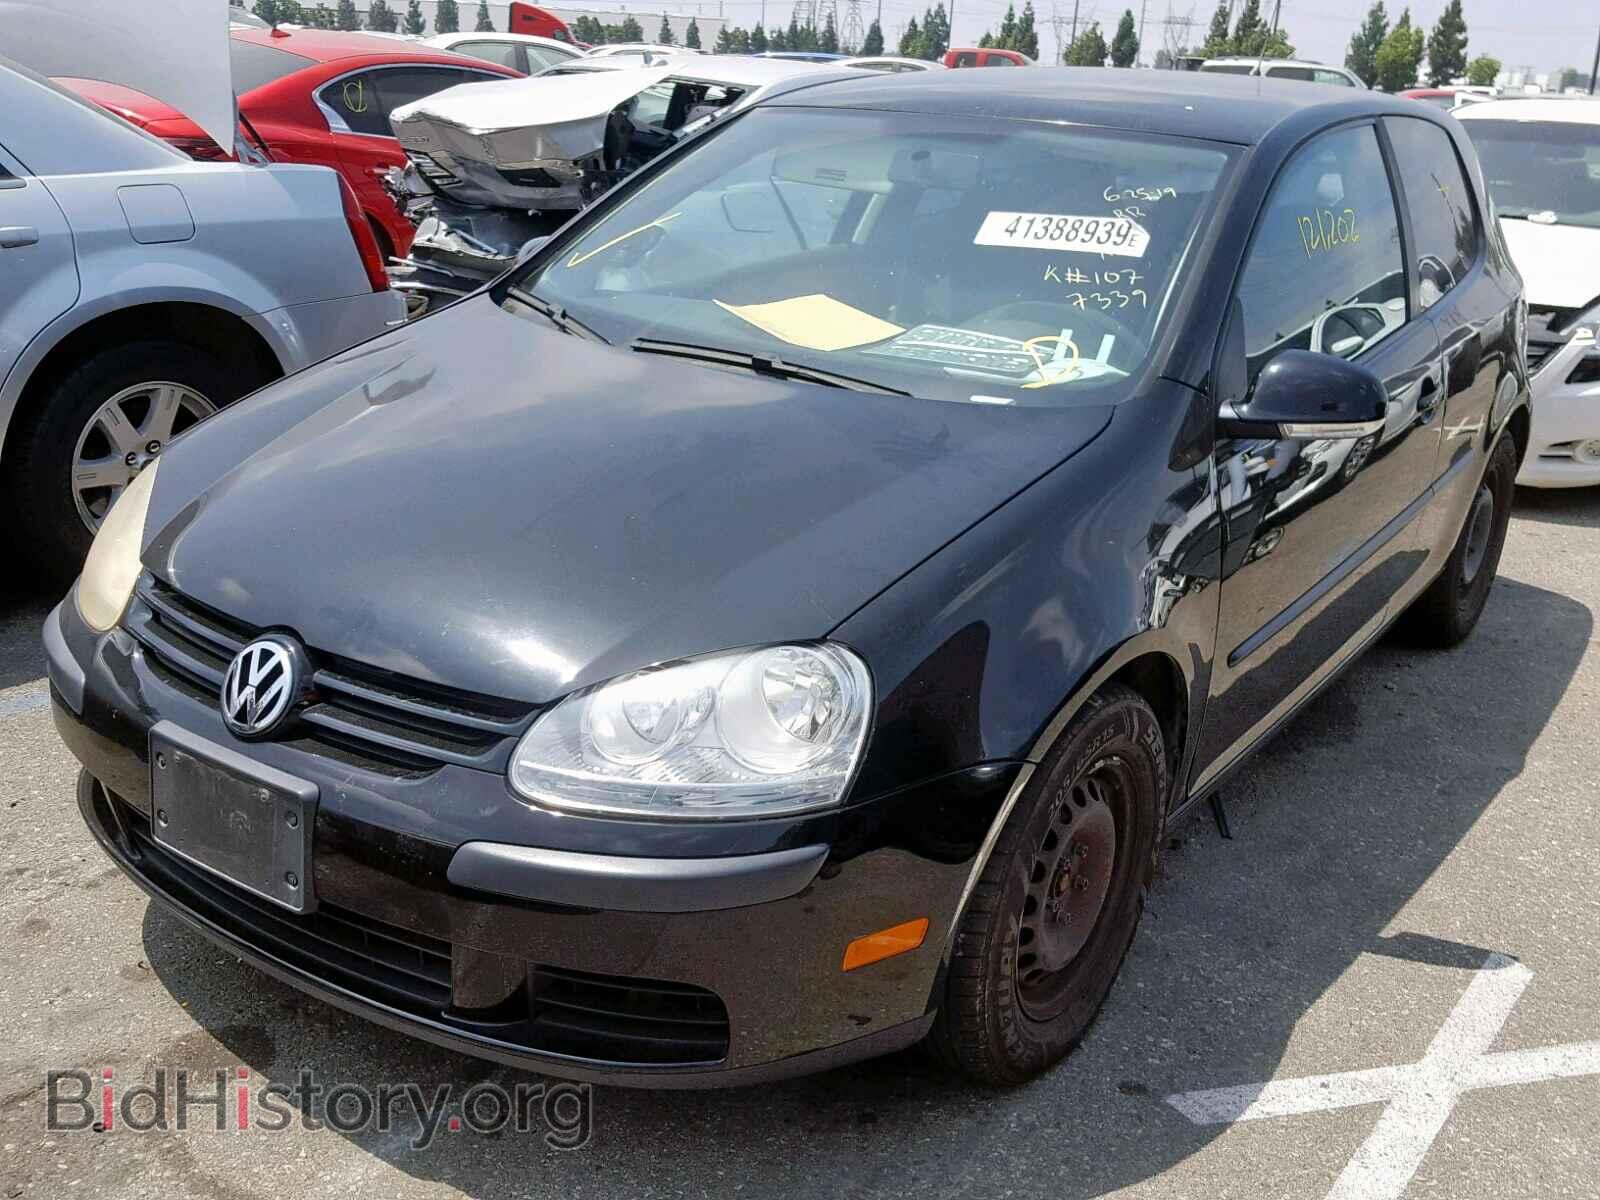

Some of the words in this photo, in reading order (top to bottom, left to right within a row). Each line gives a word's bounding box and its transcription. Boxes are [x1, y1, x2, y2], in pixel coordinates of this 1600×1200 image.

[1004, 215, 1132, 246] 41388939
[1127, 233, 1137, 247] E
[1065, 289, 1147, 311] 7339
